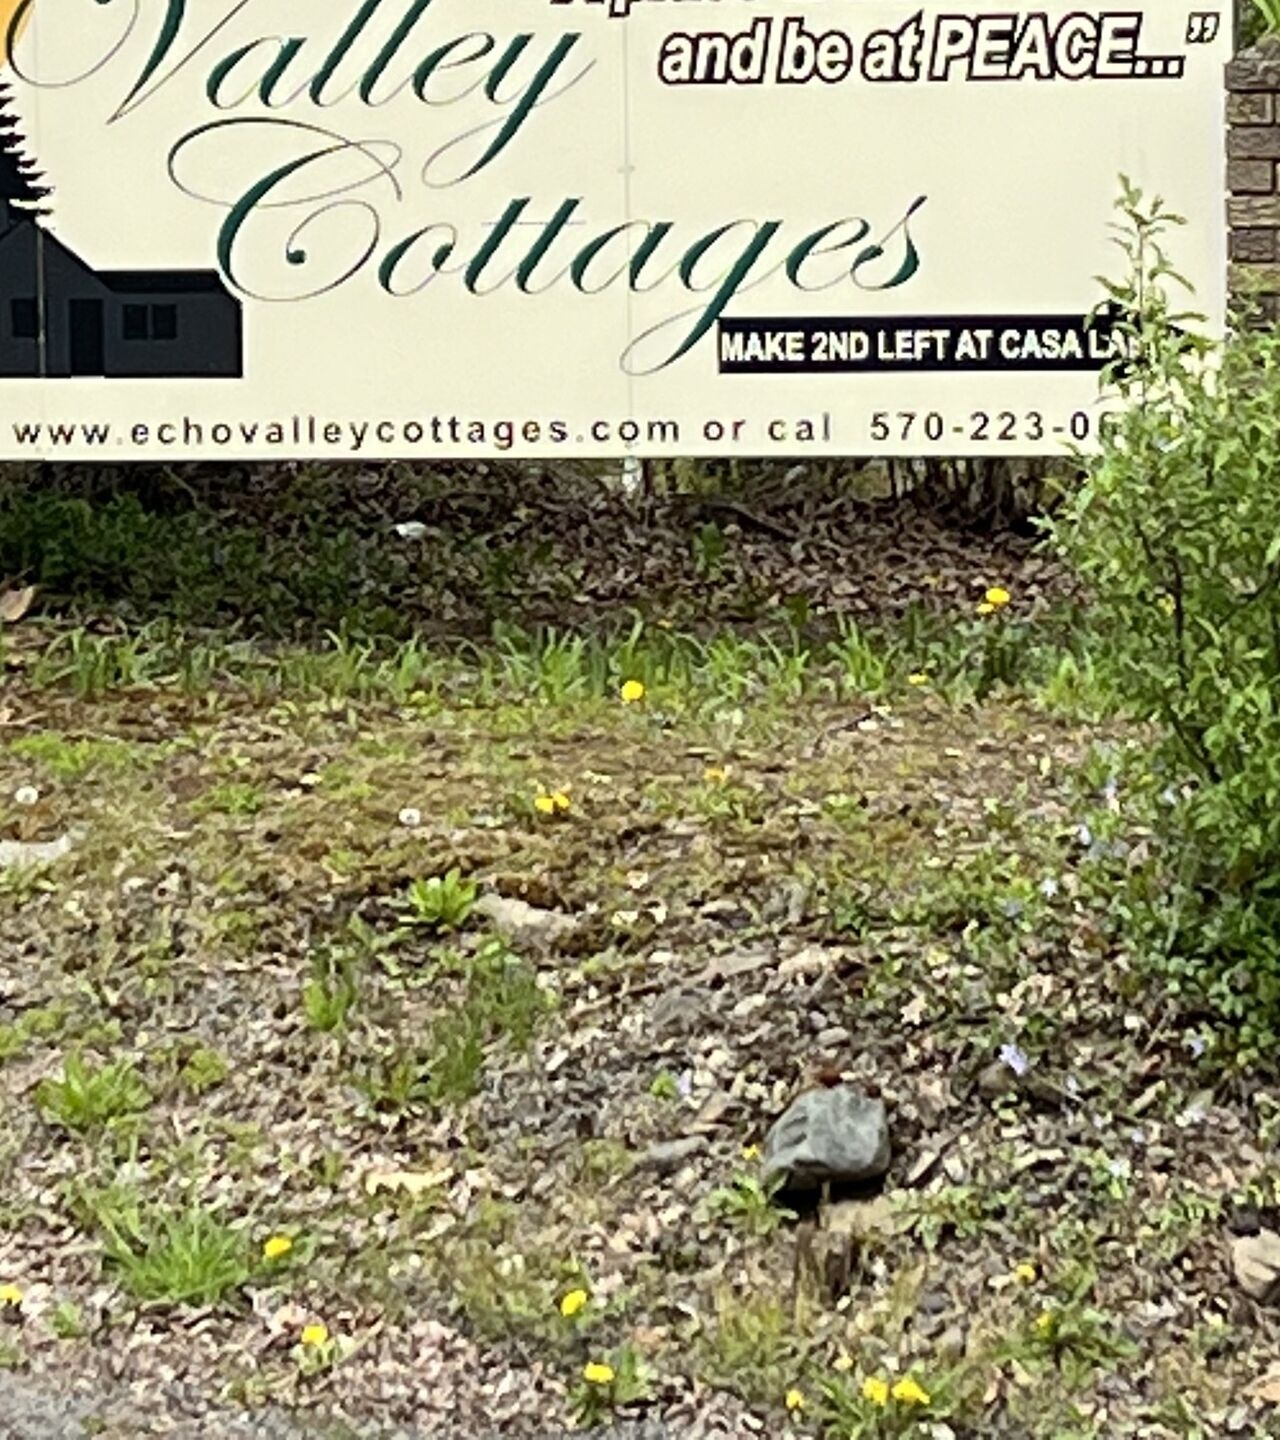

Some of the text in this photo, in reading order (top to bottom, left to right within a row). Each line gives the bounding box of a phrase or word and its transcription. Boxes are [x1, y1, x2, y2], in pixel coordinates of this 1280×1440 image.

[657, 16, 774, 85] and
[776, 16, 852, 85] be
[860, 9, 924, 83] at
[167, 116, 928, 377] Cottages
[722, 330, 805, 362] MAKE
[811, 330, 869, 361] 2ND
[877, 329, 951, 361] LEFT
[955, 329, 995, 360] AT
[999, 329, 1084, 360] CASA
[12, 414, 680, 451] www.echovalleycottages.com
[703, 419, 746, 442] or
[768, 411, 831, 442] cal
